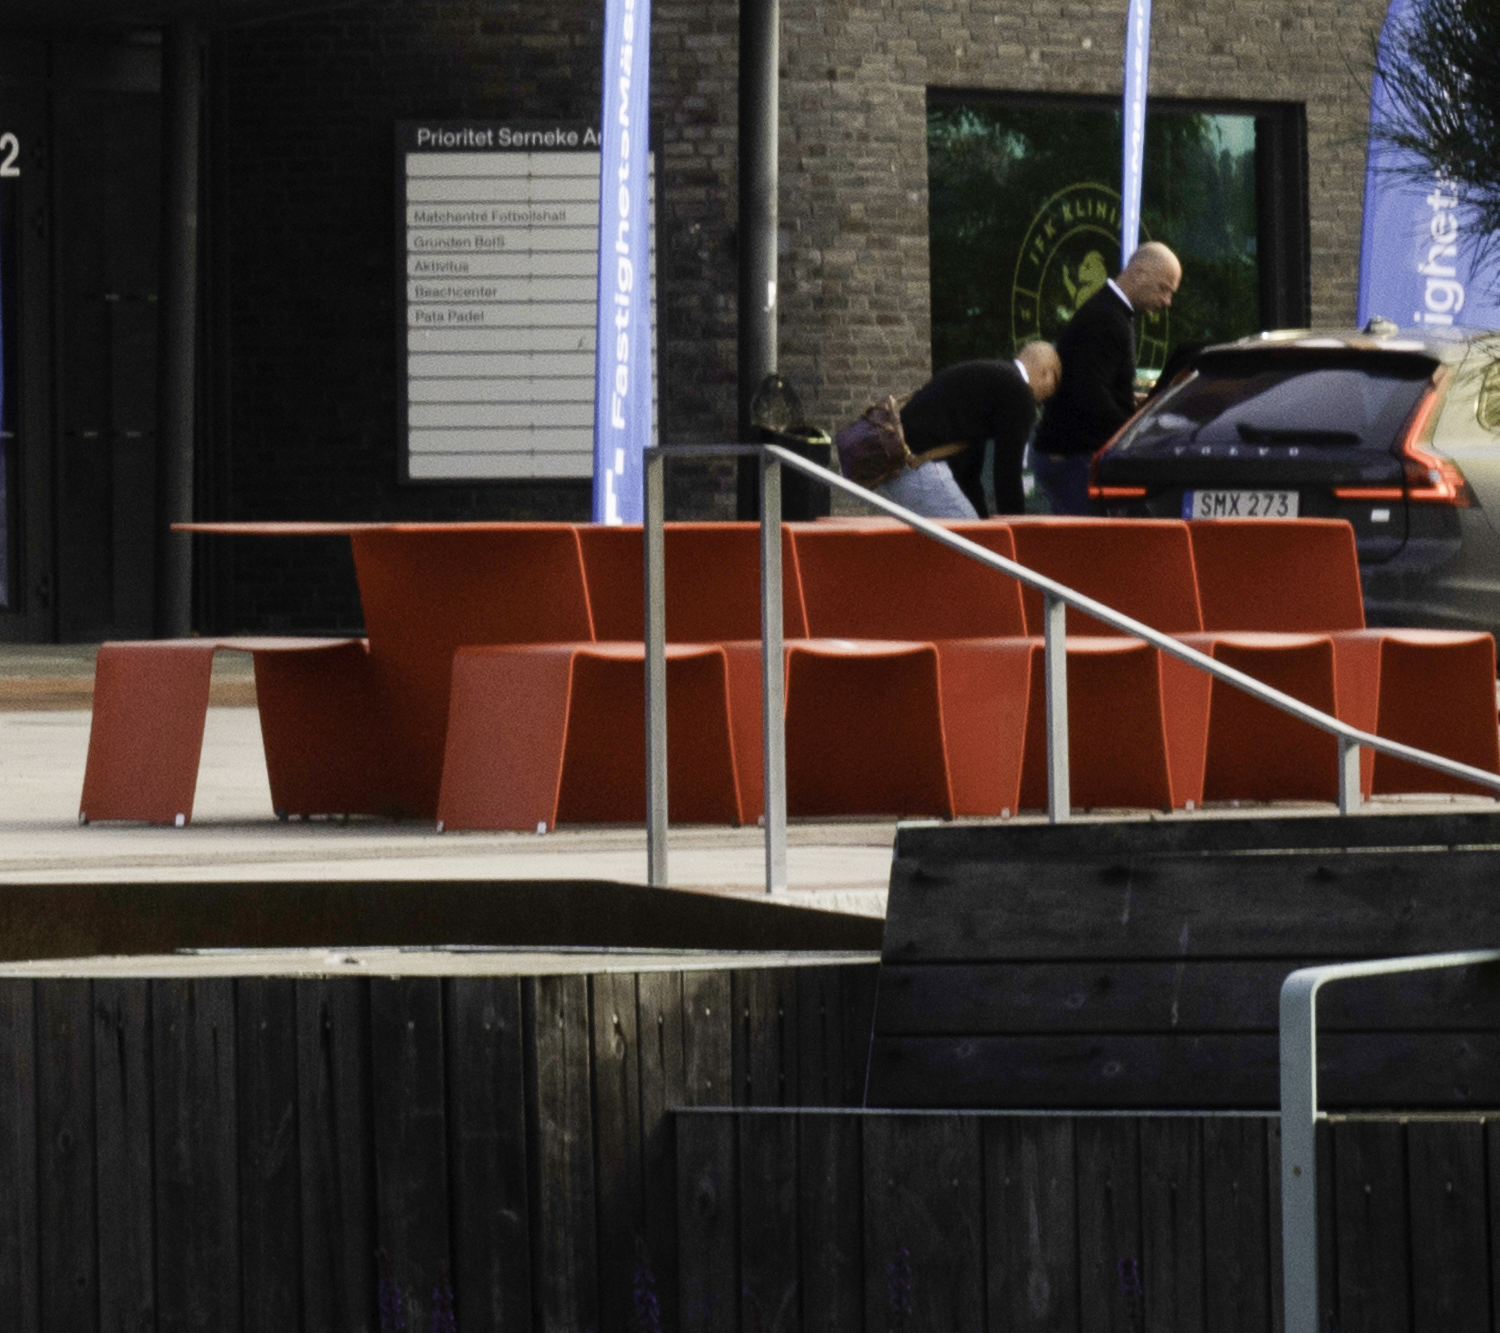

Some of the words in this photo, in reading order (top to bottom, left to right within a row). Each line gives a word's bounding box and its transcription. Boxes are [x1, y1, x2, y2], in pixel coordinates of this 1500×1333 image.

[417, 127, 494, 147] Prioritet
[499, 127, 579, 147] Serneke
[1061, 196, 1122, 230] KLINI
[1200, 492, 1241, 517] SMX
[1247, 492, 1290, 517] 273
